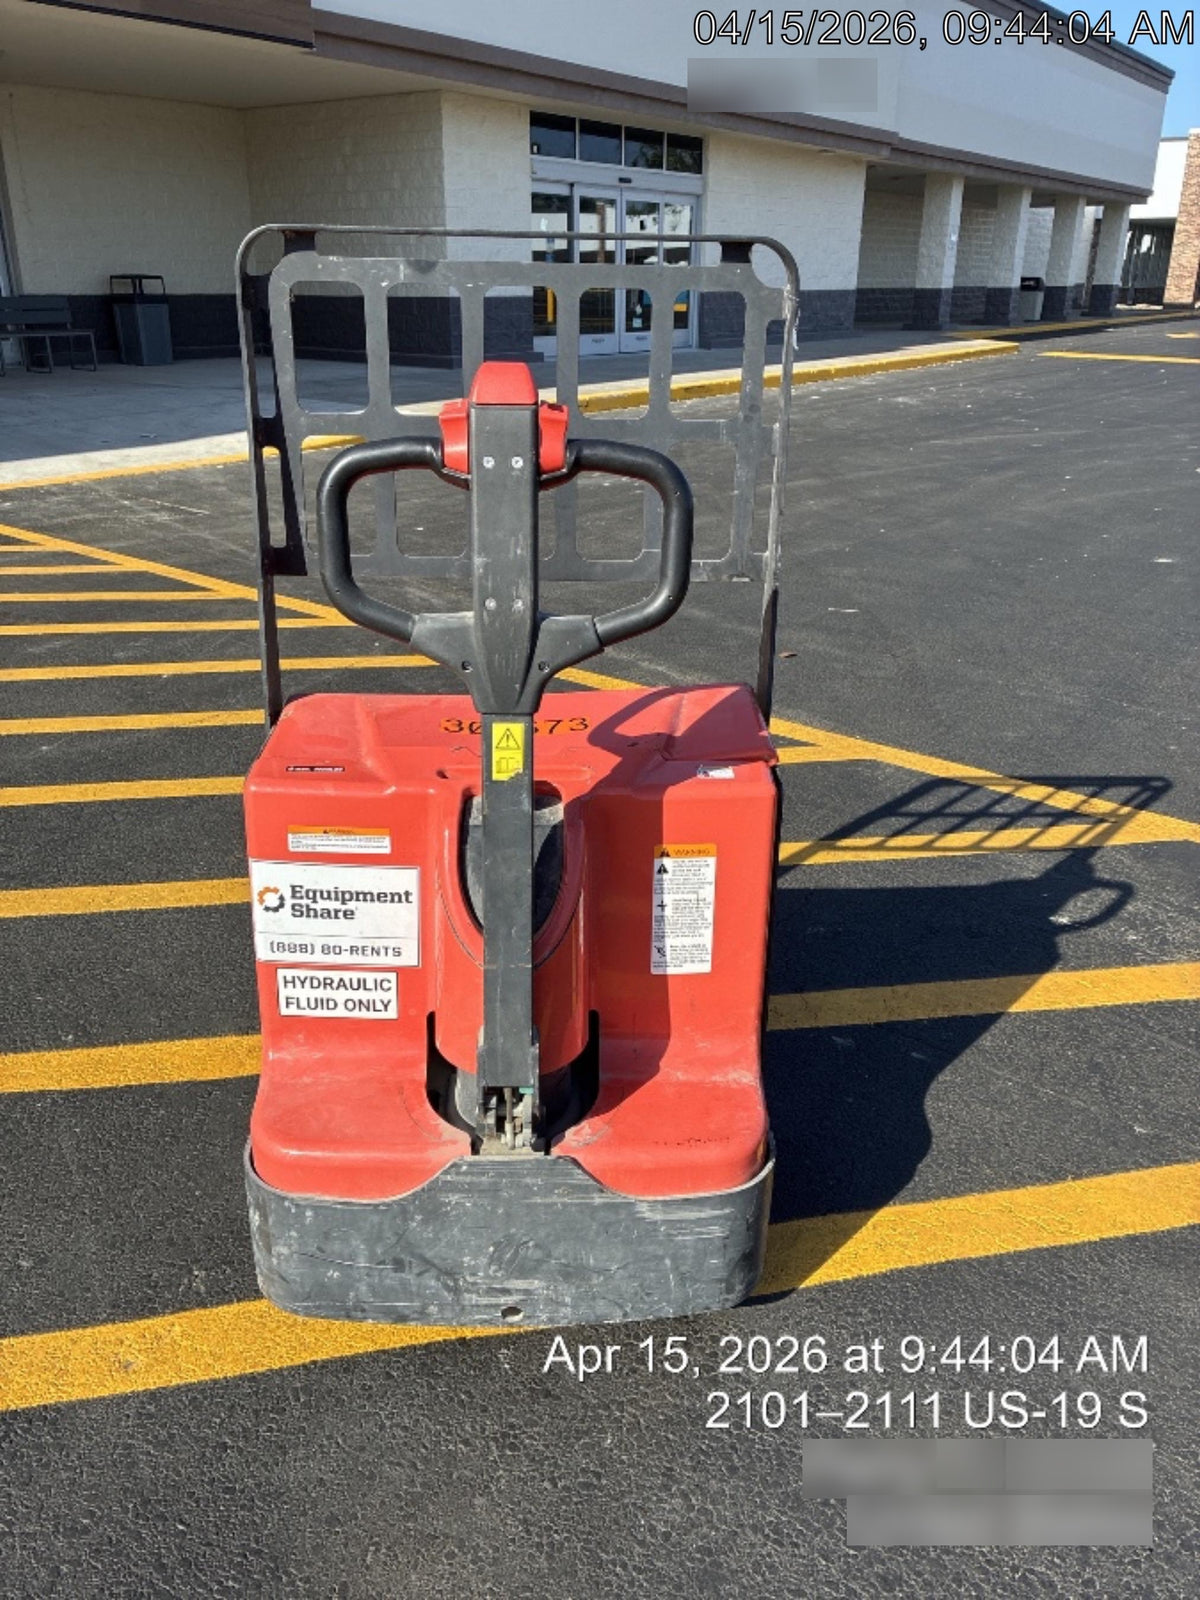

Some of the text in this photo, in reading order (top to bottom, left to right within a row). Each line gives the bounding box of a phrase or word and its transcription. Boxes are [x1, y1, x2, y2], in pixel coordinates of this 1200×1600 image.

[443, 717, 589, 734] 3073
[290, 885, 413, 905] Equipment
[291, 903, 355, 920] Share
[270, 941, 403, 957] (888) 80-RENTS
[283, 975, 393, 992] HYDRAULIC
[285, 996, 392, 1012] FLUID ONLY
